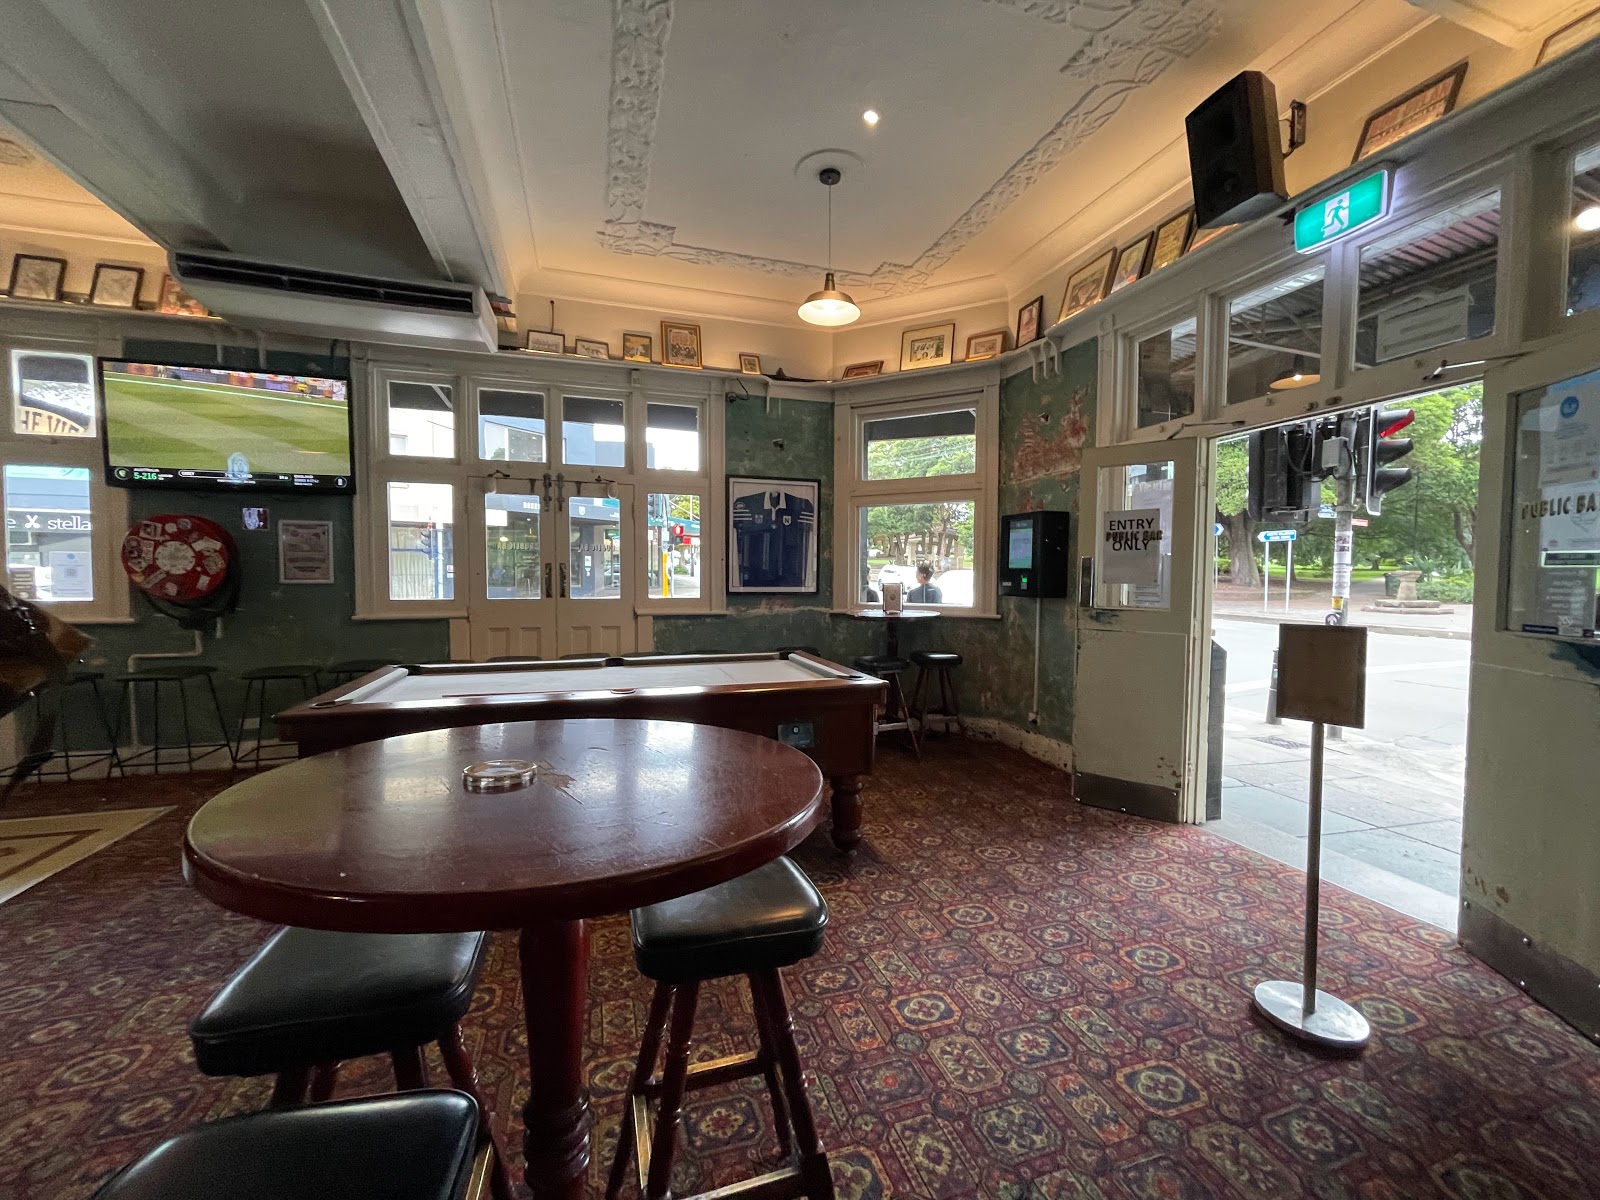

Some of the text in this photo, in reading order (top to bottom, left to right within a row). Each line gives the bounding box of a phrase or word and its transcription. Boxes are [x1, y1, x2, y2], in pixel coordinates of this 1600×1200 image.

[134, 472, 158, 480] 5-216
[1521, 492, 1600, 520] PUBLIC BA
[47, 515, 92, 531] stella
[1109, 517, 1155, 531] ENTRY
[1105, 530, 1140, 542] PUBLIC
[1112, 539, 1150, 551] ONLY
